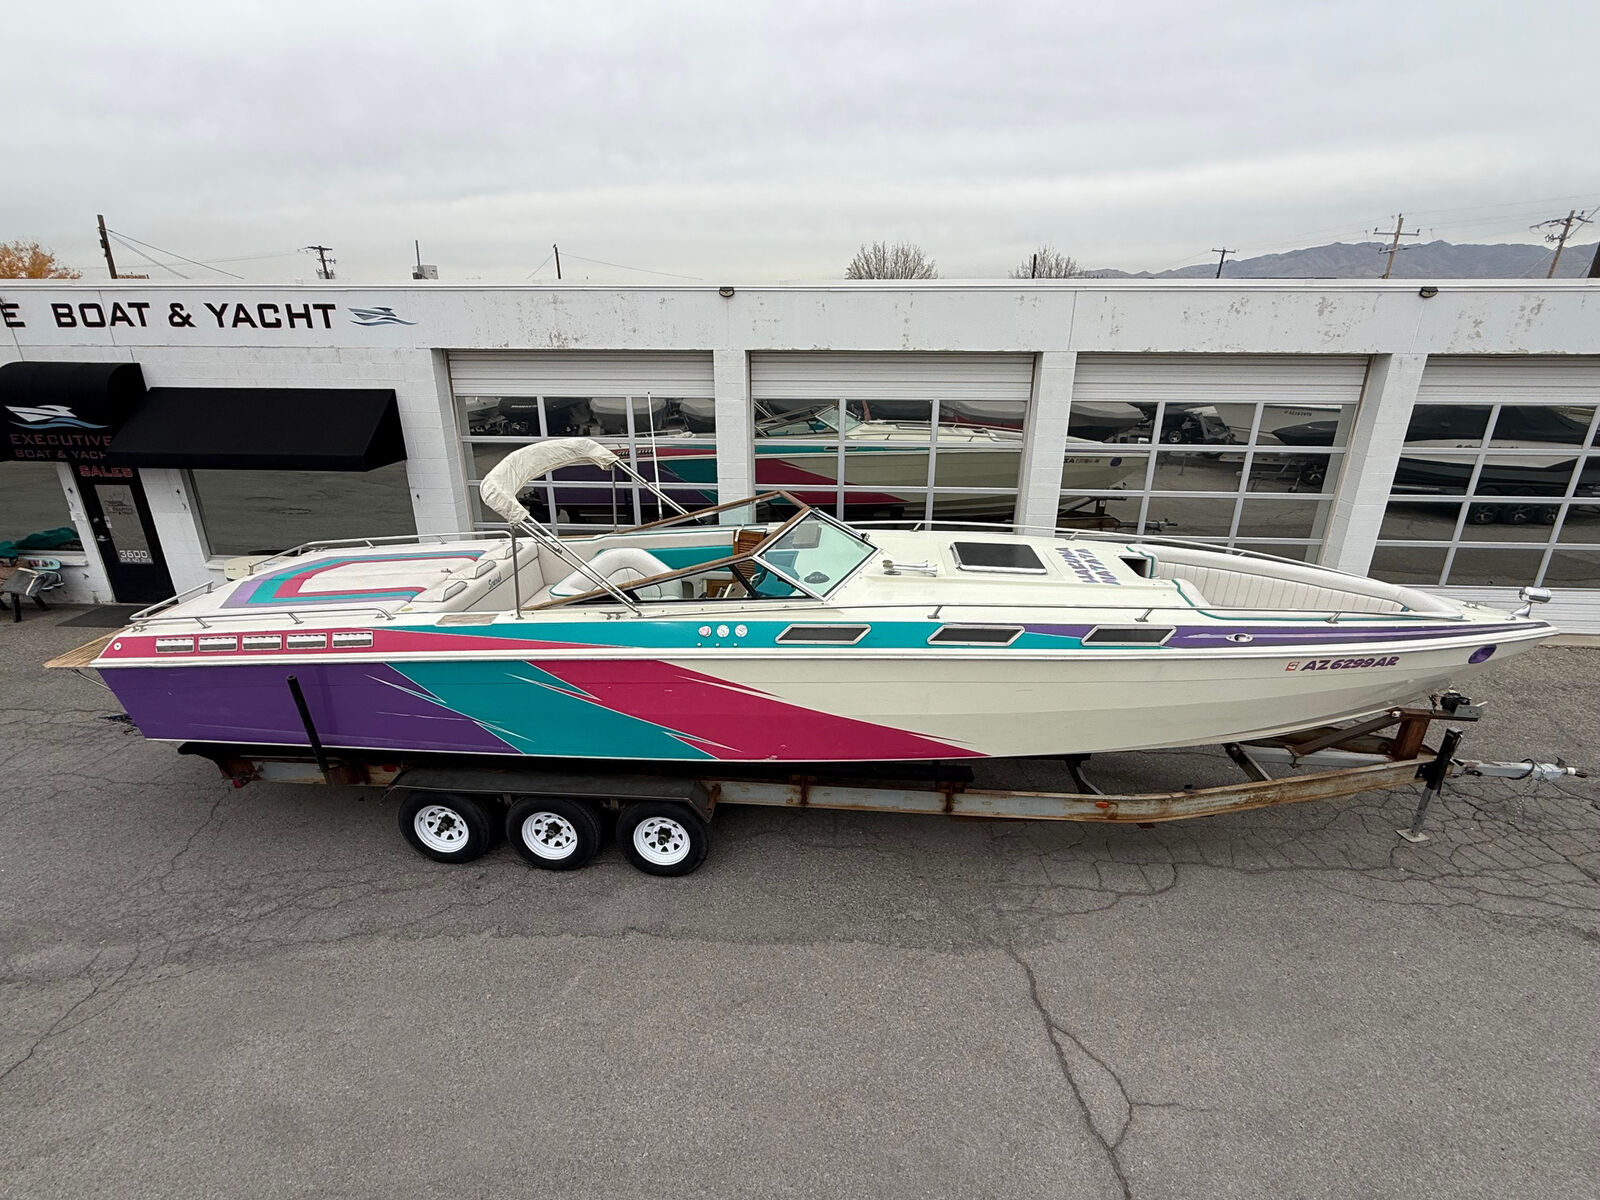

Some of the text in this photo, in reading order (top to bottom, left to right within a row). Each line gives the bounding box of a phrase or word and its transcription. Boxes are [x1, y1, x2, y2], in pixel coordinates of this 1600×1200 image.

[50, 302, 151, 328] BOAT
[168, 302, 197, 328] &
[203, 302, 337, 329] YACHT
[9, 433, 113, 446] EXECUTIVE
[15, 449, 107, 460] BOAT & YACH
[79, 465, 133, 478] SALES
[119, 550, 148, 559] 3600
